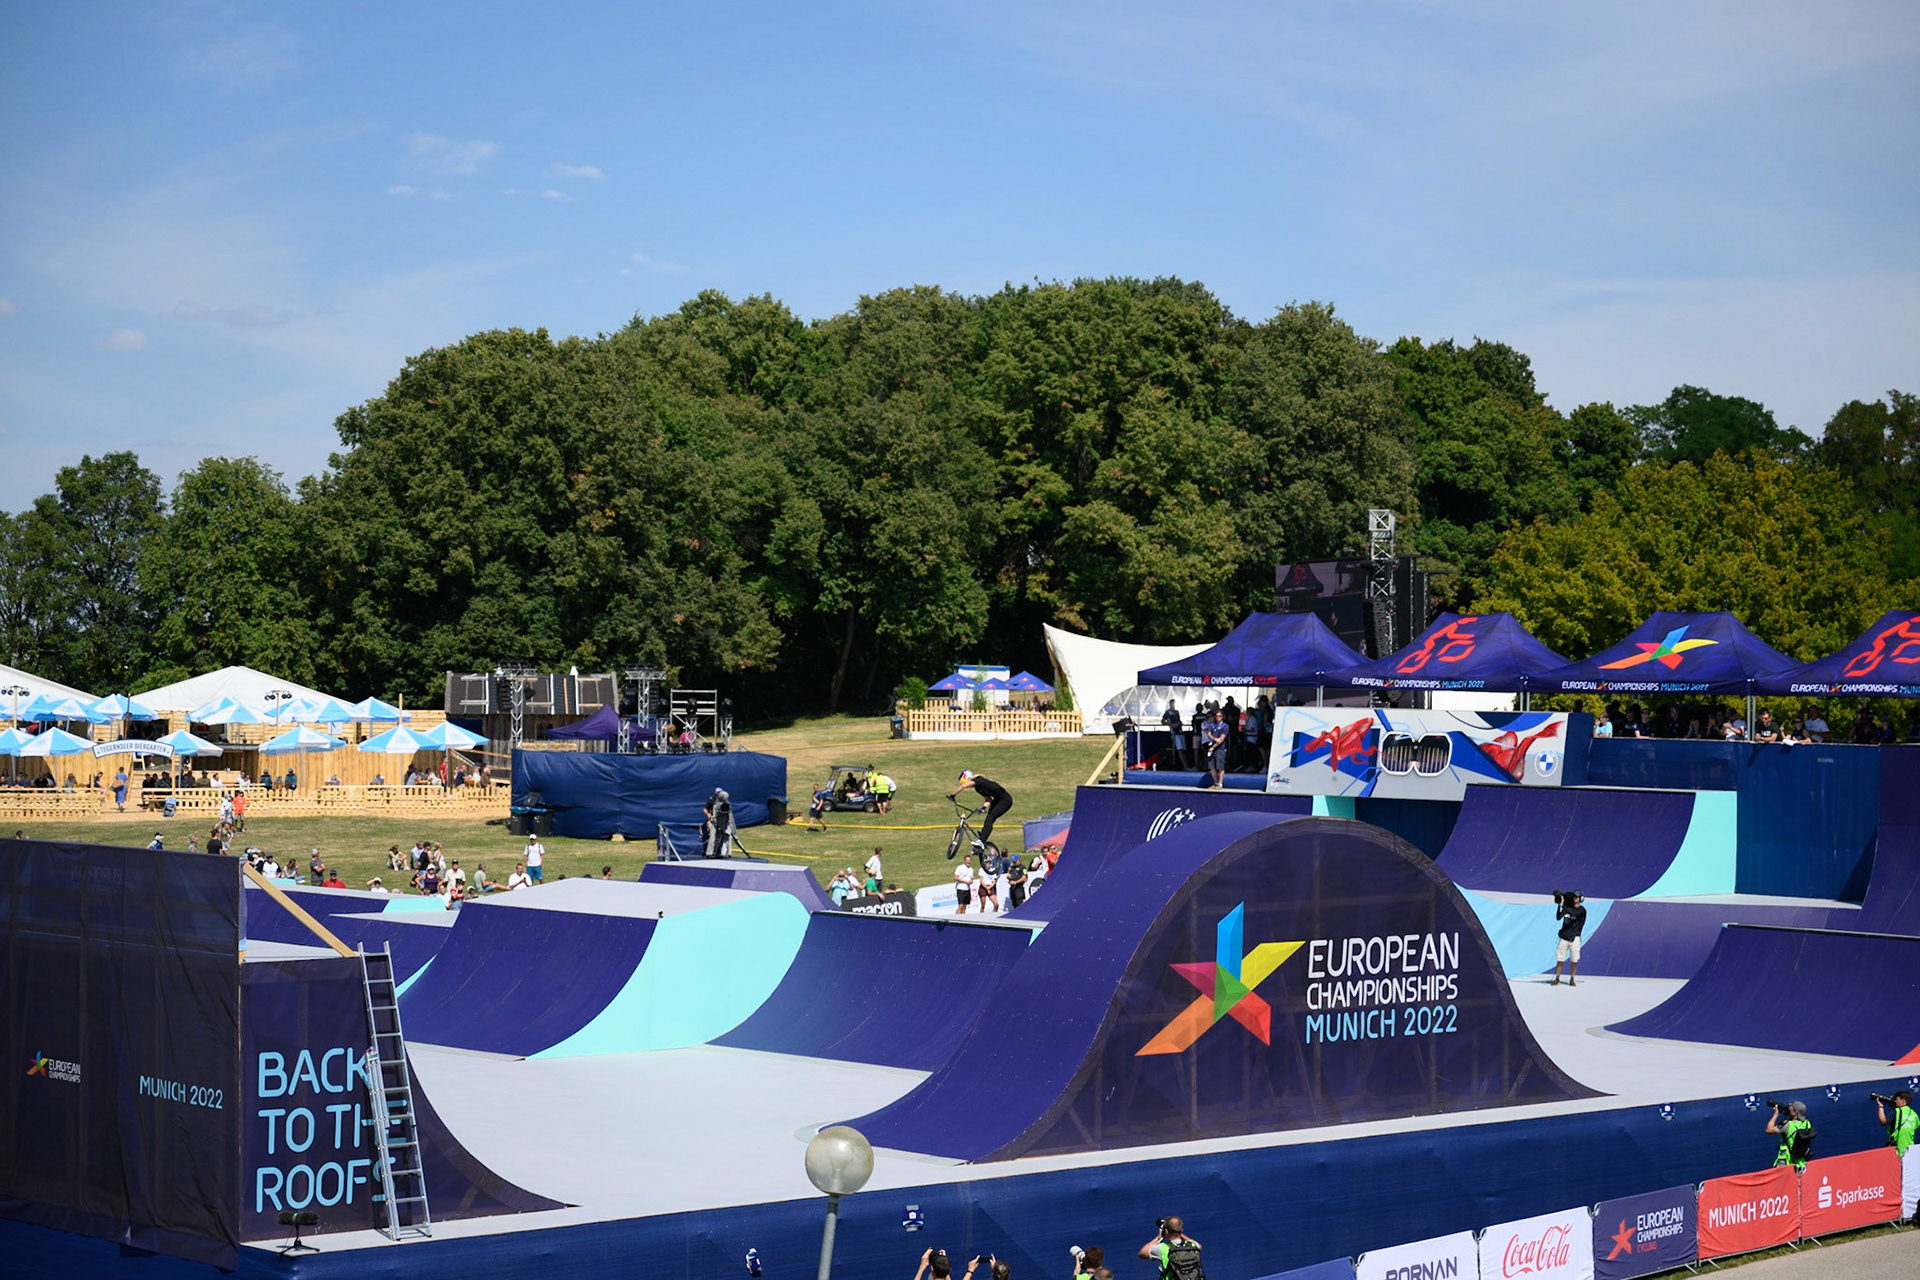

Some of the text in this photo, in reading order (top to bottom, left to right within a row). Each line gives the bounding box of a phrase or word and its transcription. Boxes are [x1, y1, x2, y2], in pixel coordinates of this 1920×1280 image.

[1172, 675, 1202, 684] EUROPEAN
[1210, 676, 1253, 685] CHAMPIONSHIPS
[1351, 677, 1485, 689] EUROPEAN CHAMPIONSHIPS MUNICH 2022
[1562, 680, 1709, 691] EUROPEAN CHAMPIONSHIPS MUNICH 2022
[1790, 683, 1920, 694] EUROPEAN CHAMPIONSHIPS MUN
[100, 742, 167, 752] TEGERNSEER BIERGARTEN
[852, 902, 902, 915] macron
[1308, 932, 1459, 979] EUROPEAN
[1306, 974, 1458, 1010] CHAMPIONSHIPS
[1305, 1004, 1458, 1044] MUNICH 2022
[48, 1058, 81, 1075] EUROPEAN
[258, 1047, 373, 1098] BACK
[139, 1074, 223, 1109] MUNICH 2022
[258, 1107, 315, 1155] TO
[1835, 1184, 1885, 1208] Sparkasse
[1637, 1205, 1684, 1231] EUROPEAN
[1709, 1194, 1789, 1229] MUNICH 2022
[1637, 1222, 1684, 1243] CHAMPIONSHIPS
[1502, 1223, 1574, 1278] Coca-Cola
